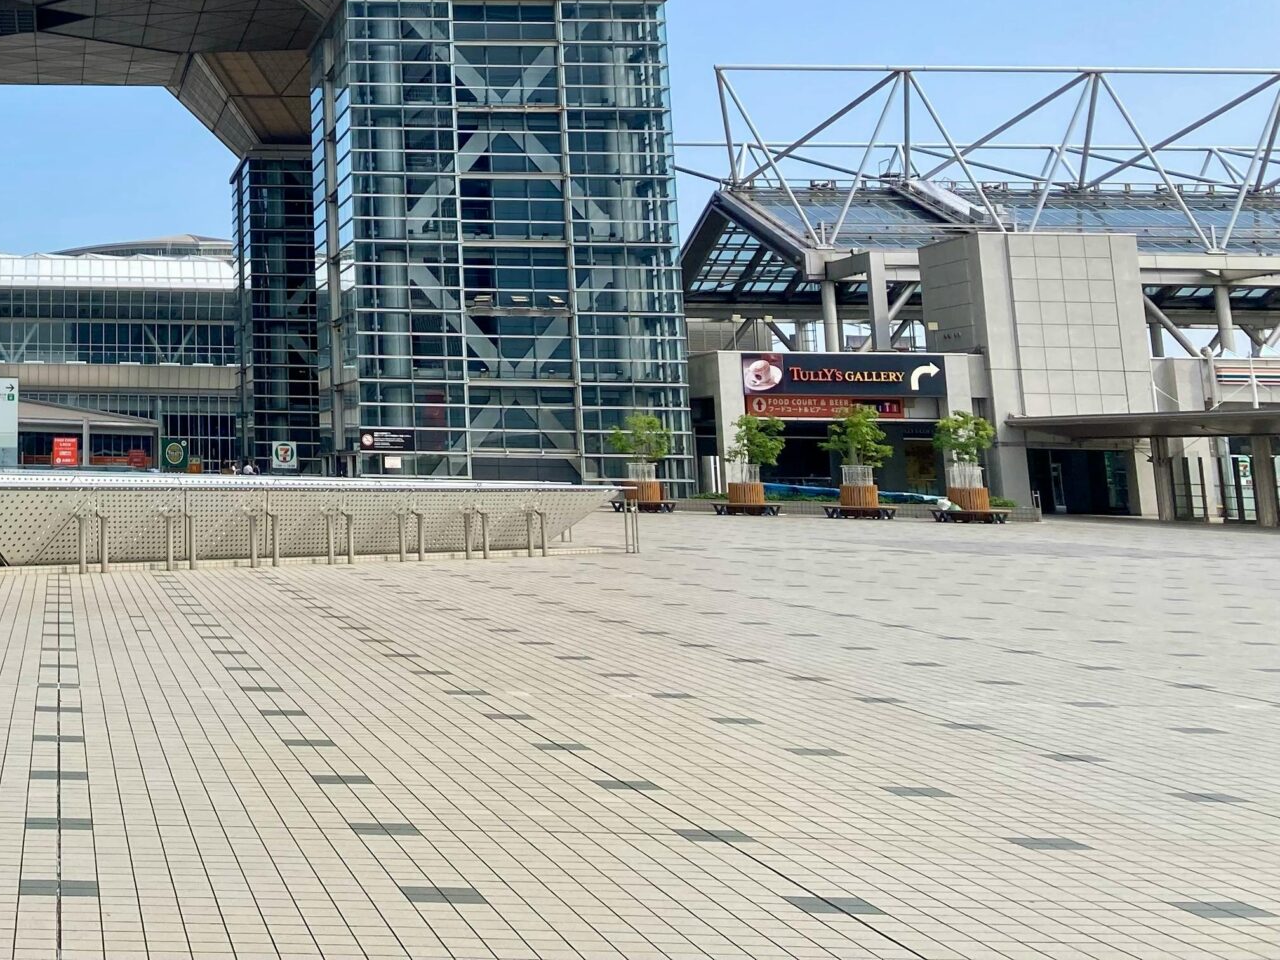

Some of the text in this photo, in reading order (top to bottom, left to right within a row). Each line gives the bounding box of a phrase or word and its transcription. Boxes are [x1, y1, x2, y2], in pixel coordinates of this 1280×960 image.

[789, 367, 905, 382] TULLY'S GALLERY
[767, 398, 790, 406] FOOD
[829, 399, 849, 407] BEER
